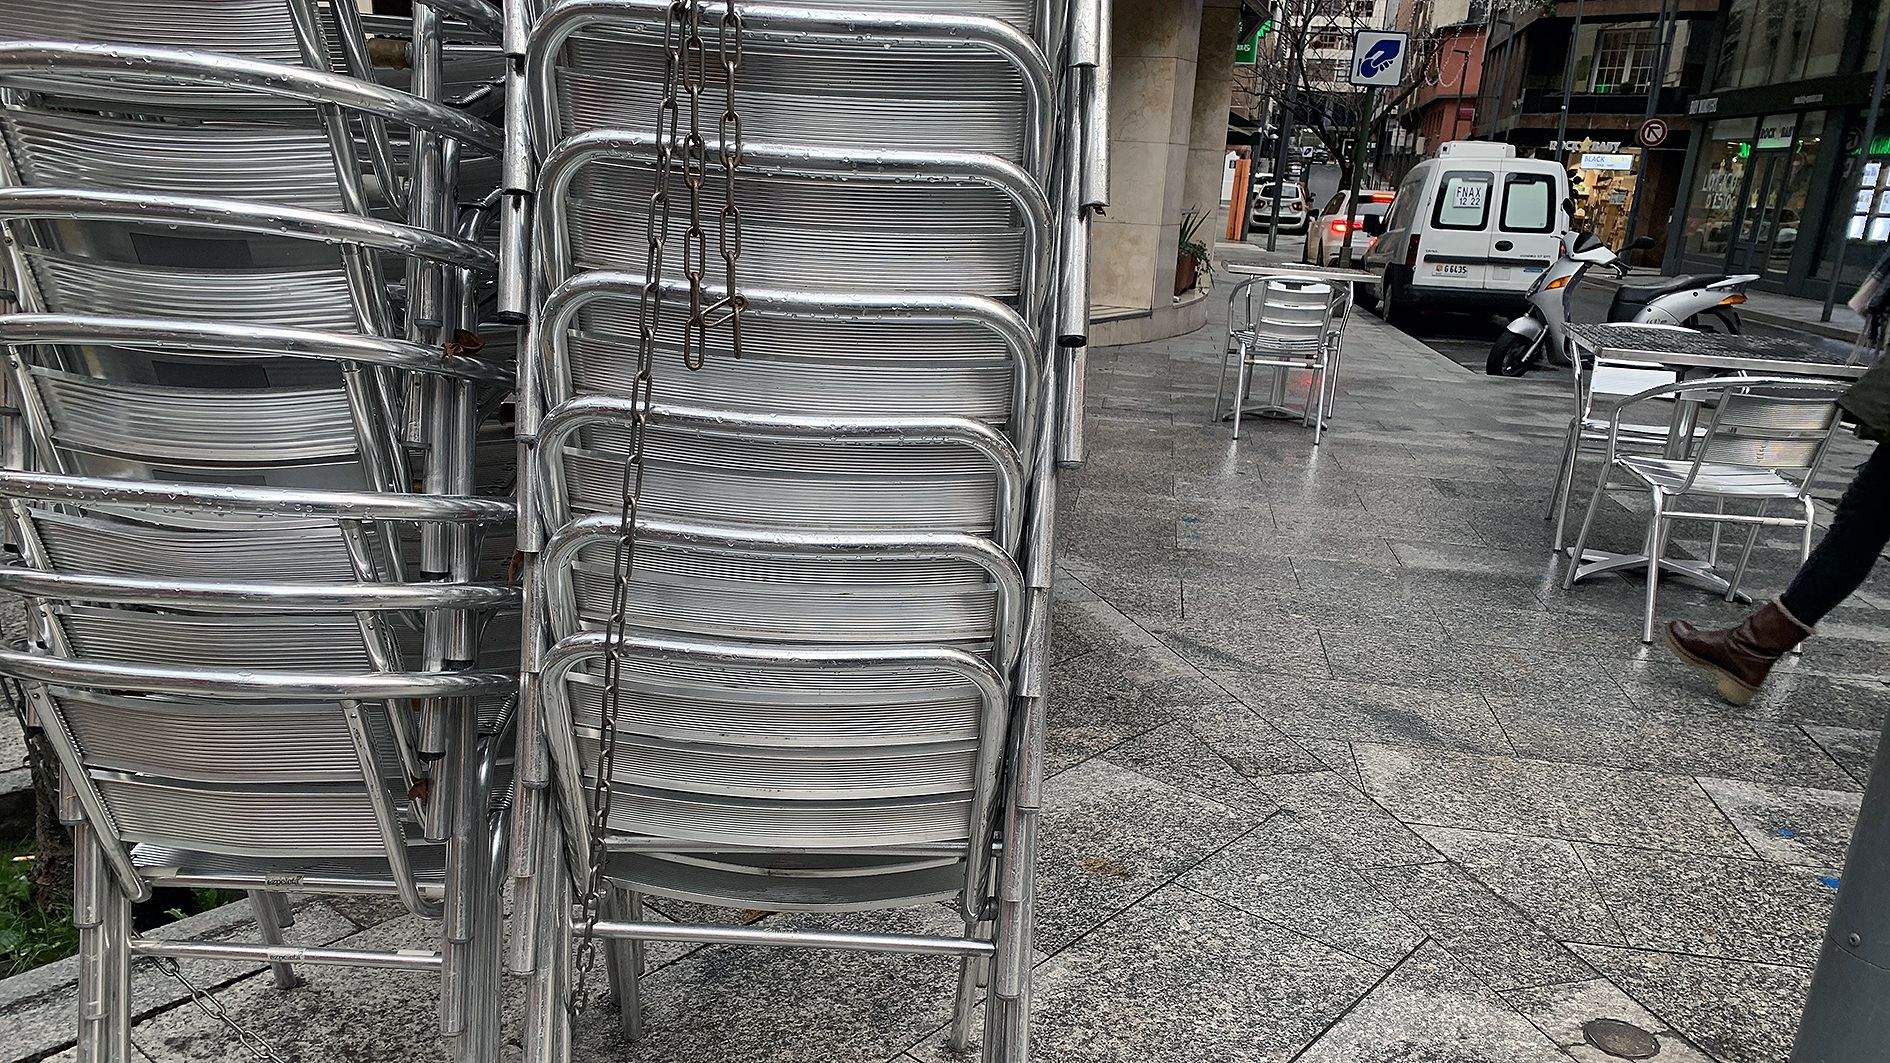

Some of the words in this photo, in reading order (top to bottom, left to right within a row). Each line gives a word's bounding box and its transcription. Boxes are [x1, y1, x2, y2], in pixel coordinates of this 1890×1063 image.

[1456, 186, 1482, 198] FNAX
[1459, 197, 1467, 206] 12
[1470, 197, 1481, 206] 22
